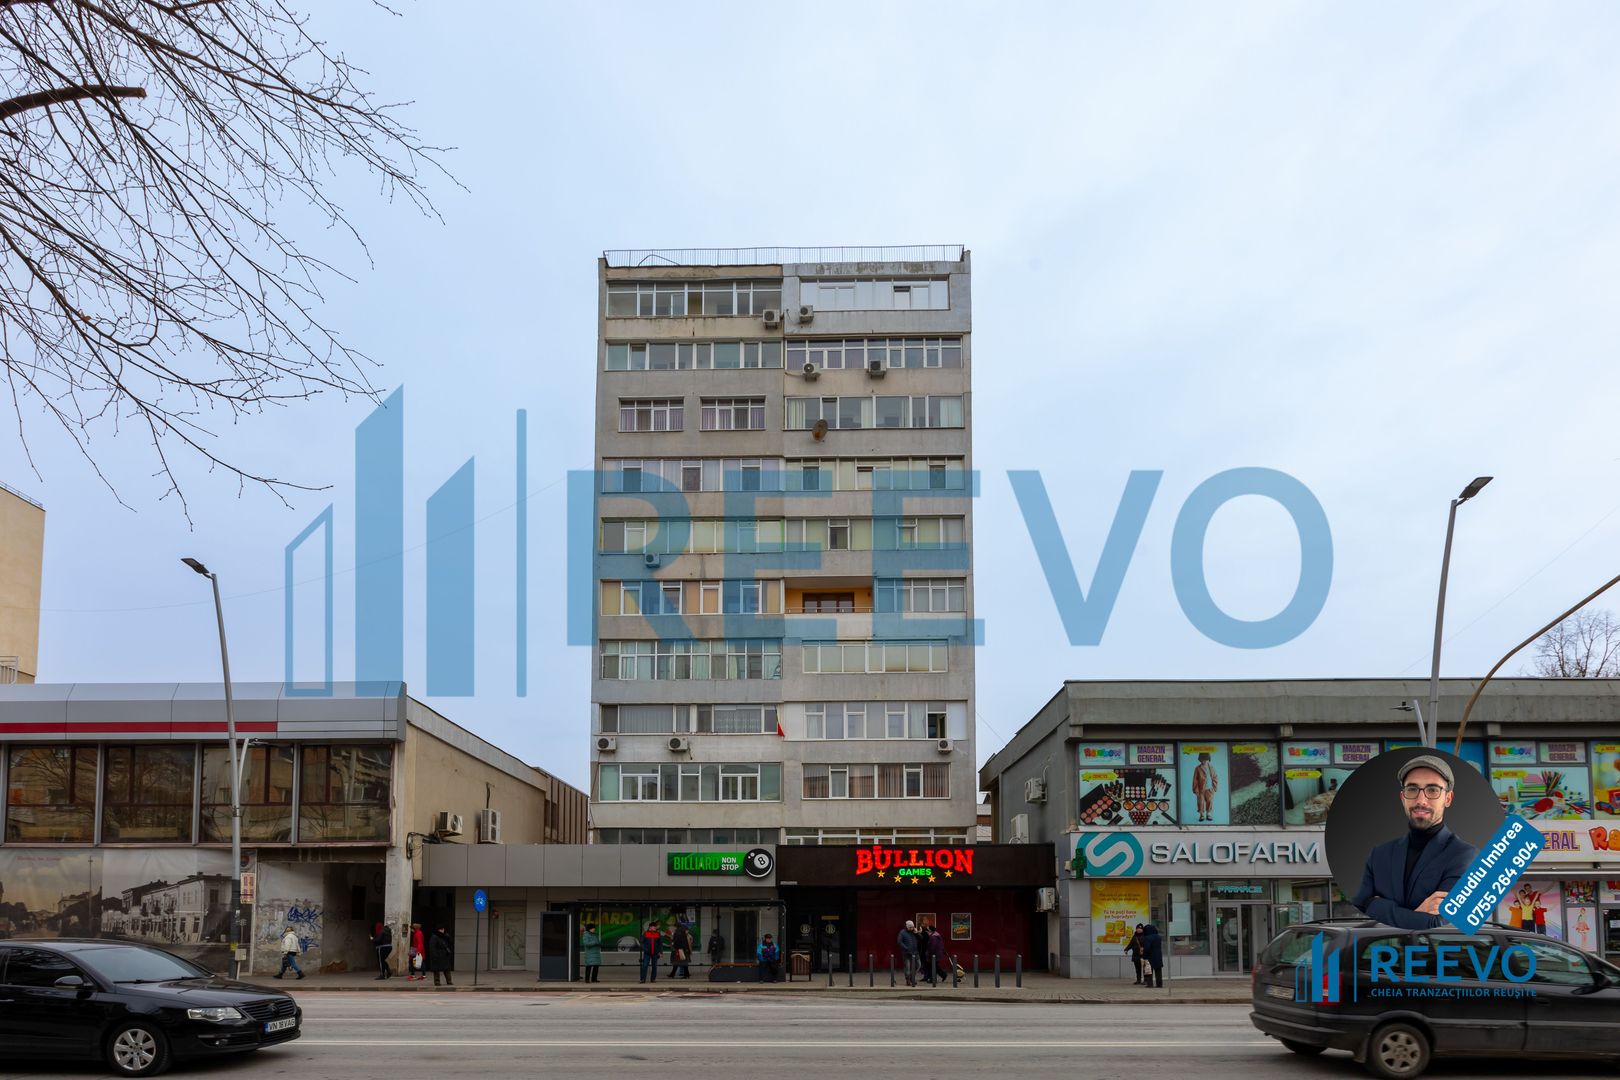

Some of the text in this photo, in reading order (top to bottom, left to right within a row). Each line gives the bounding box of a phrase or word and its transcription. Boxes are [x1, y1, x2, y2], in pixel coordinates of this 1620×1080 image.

[1137, 745, 1166, 754] MAGAZIN
[1137, 755, 1166, 763] GENERAL
[1542, 830, 1580, 851] ERAL
[855, 845, 975, 875] BULLION
[1151, 841, 1321, 865] SALOFARM
[673, 856, 720, 871] BILLIARD
[757, 856, 766, 866] 8
[898, 868, 932, 876] GAMES
[579, 911, 634, 925] LLIARD
